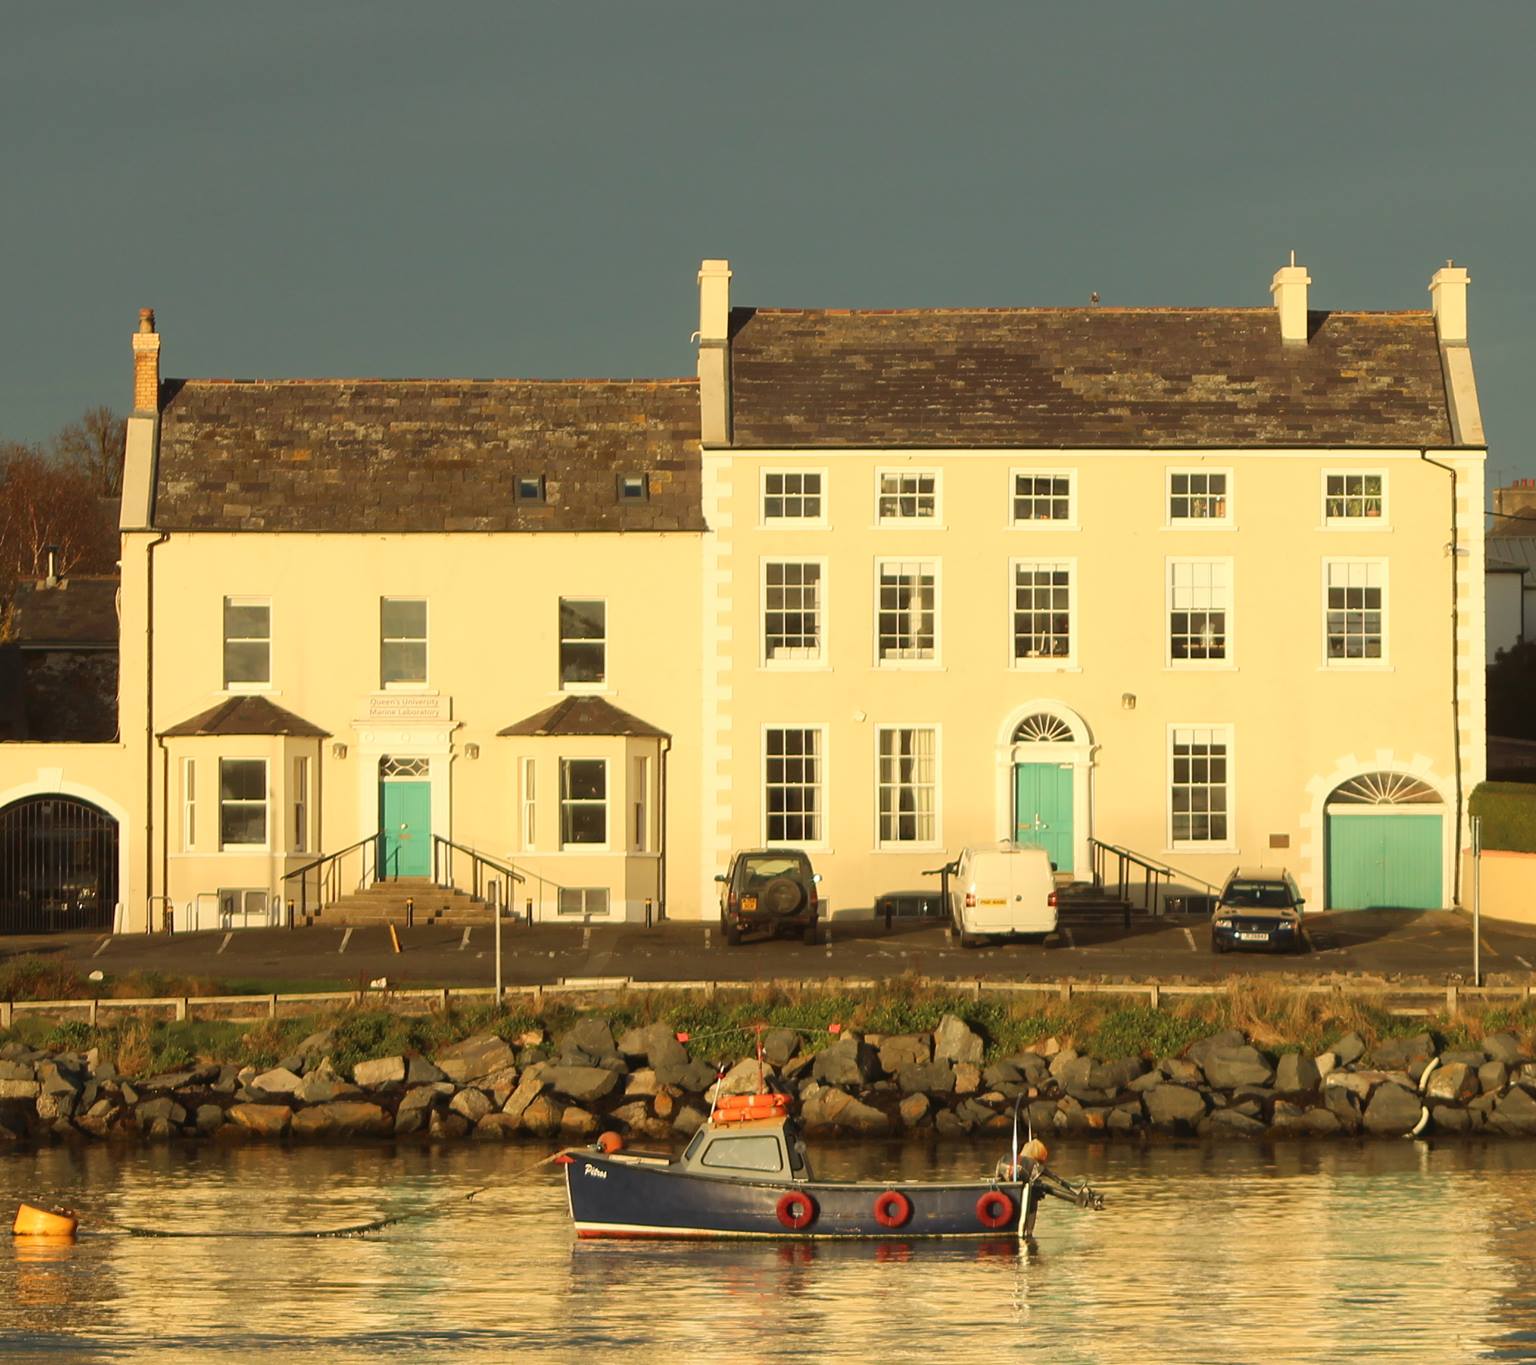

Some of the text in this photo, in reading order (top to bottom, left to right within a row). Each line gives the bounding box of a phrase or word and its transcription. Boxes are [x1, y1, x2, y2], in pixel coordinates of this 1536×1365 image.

[402, 698, 439, 707] University
[368, 708, 440, 718] Marine Laboratory
